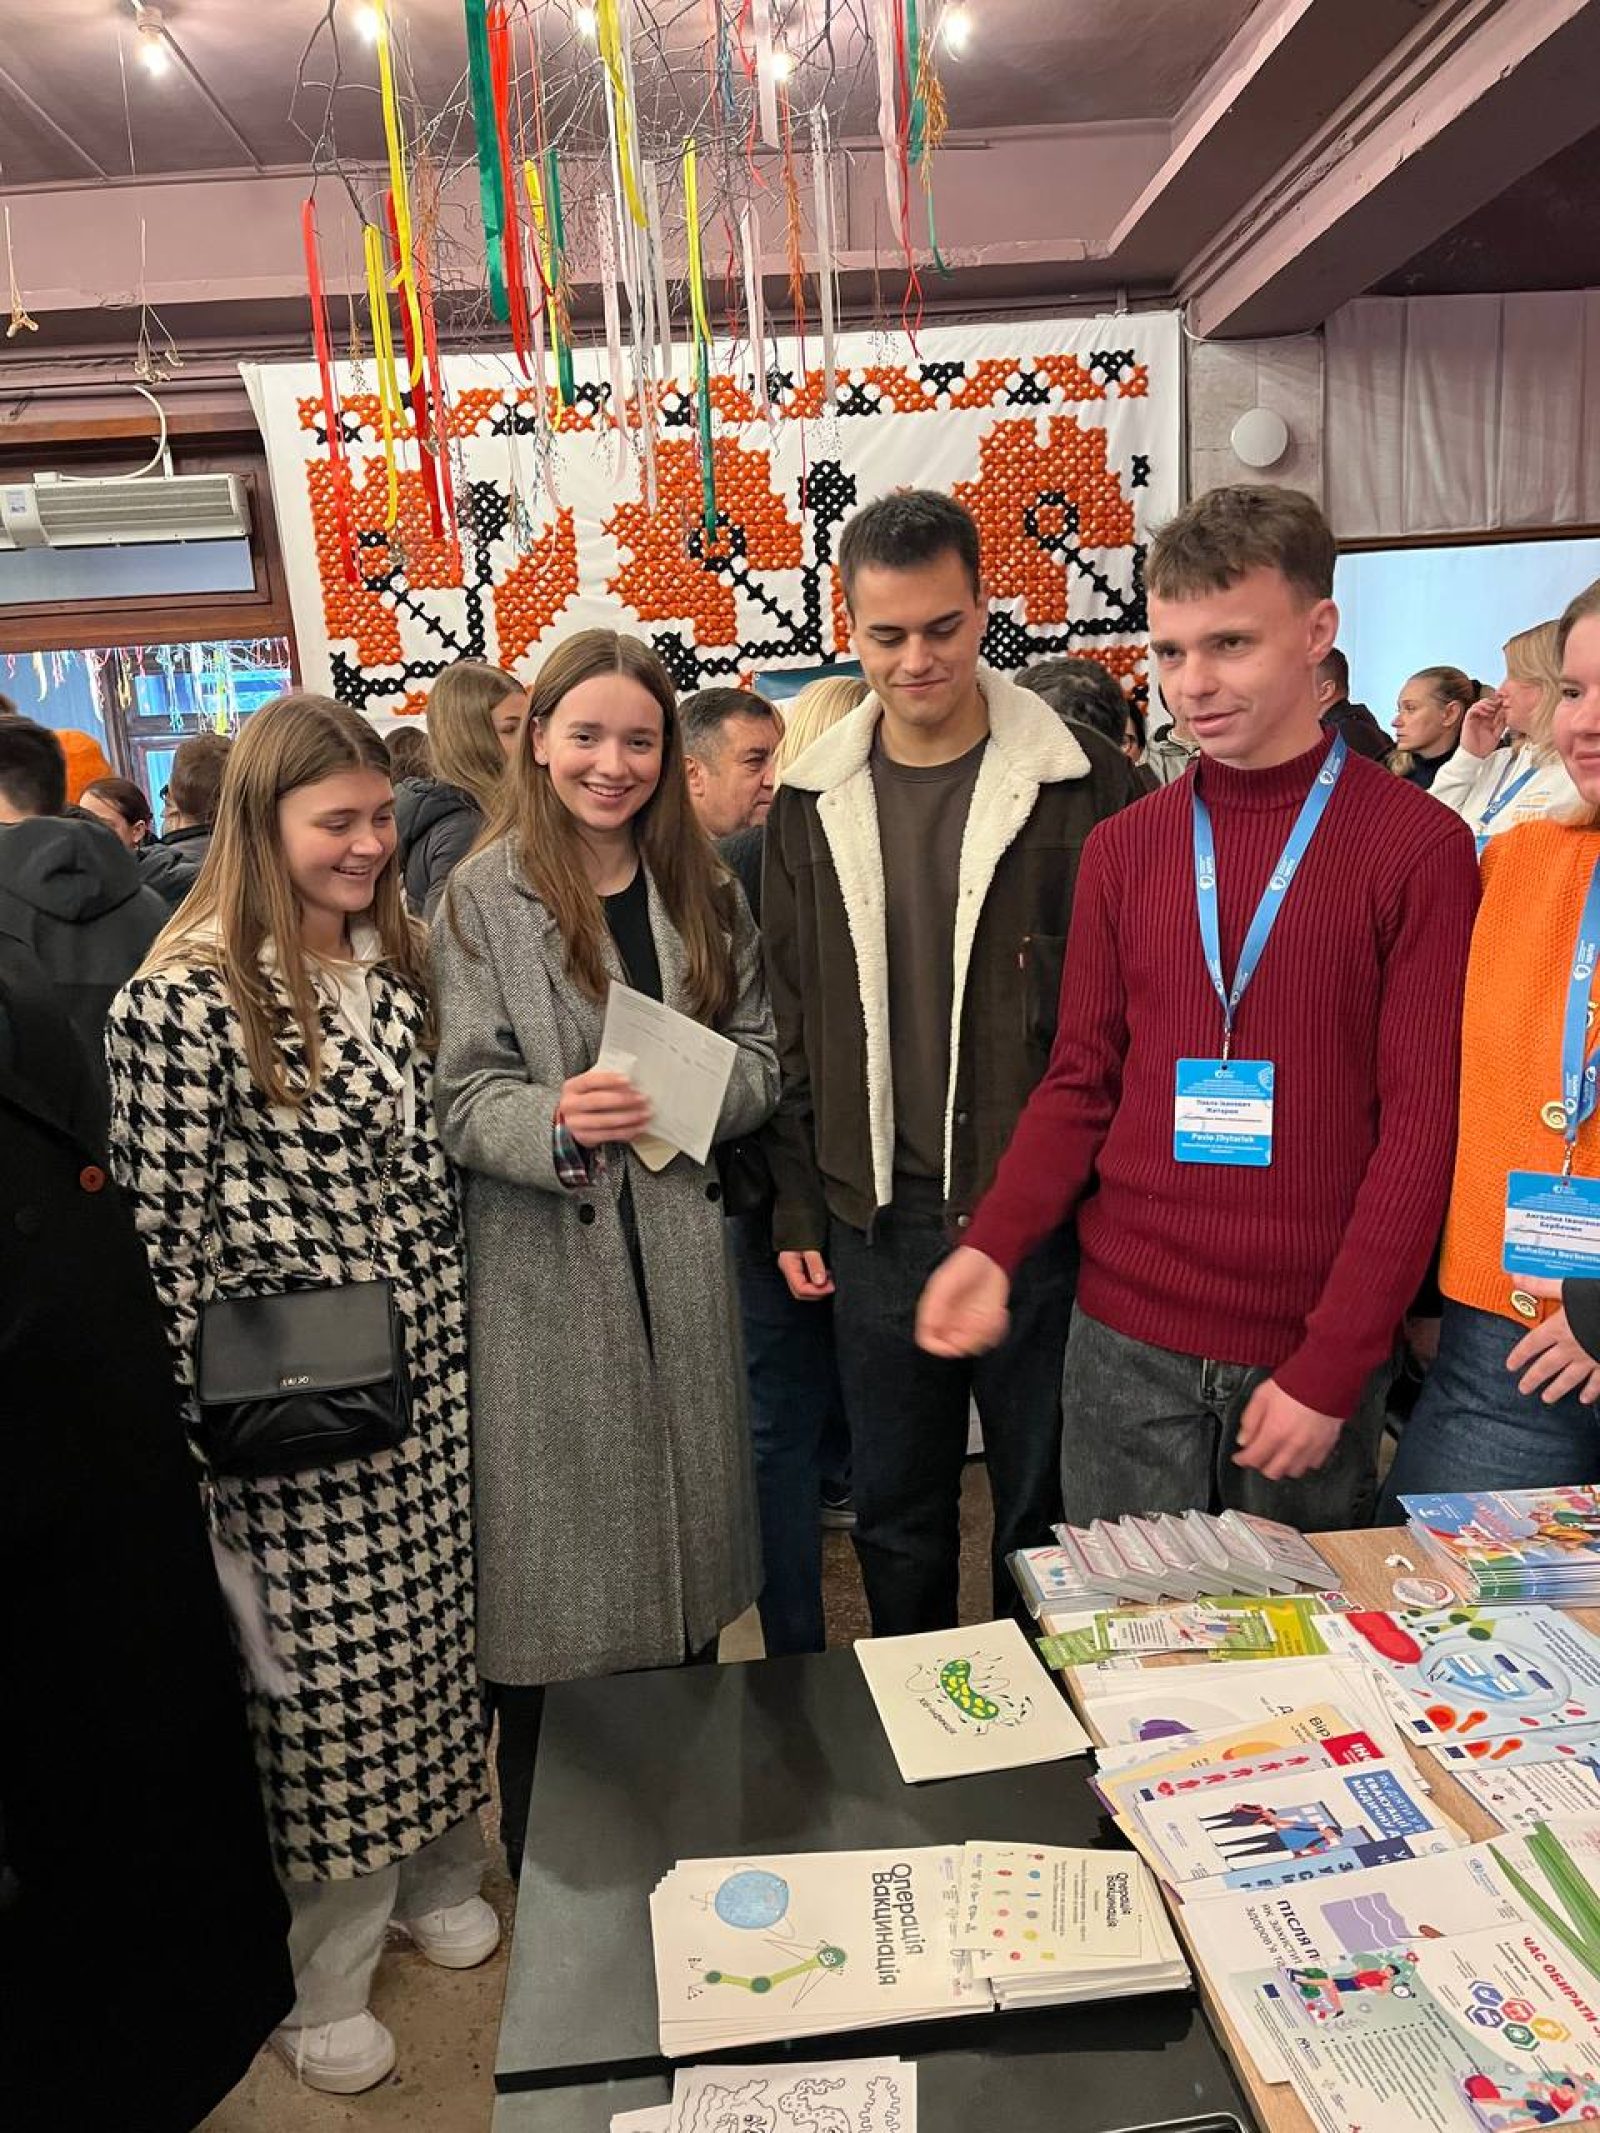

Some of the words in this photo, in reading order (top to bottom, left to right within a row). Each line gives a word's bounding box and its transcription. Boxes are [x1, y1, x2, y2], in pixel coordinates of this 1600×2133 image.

[891, 1862, 926, 1955] Операція
[1106, 1874, 1119, 1928] Вакцинація
[1115, 1872, 1131, 1915] Операція
[1276, 1899, 1313, 1946] ПІСЛЯ
[872, 1872, 901, 1986] Вакцинація
[1523, 1937, 1547, 1962] ЧАС
[1543, 1964, 1599, 2022] ОБИРАТИ
